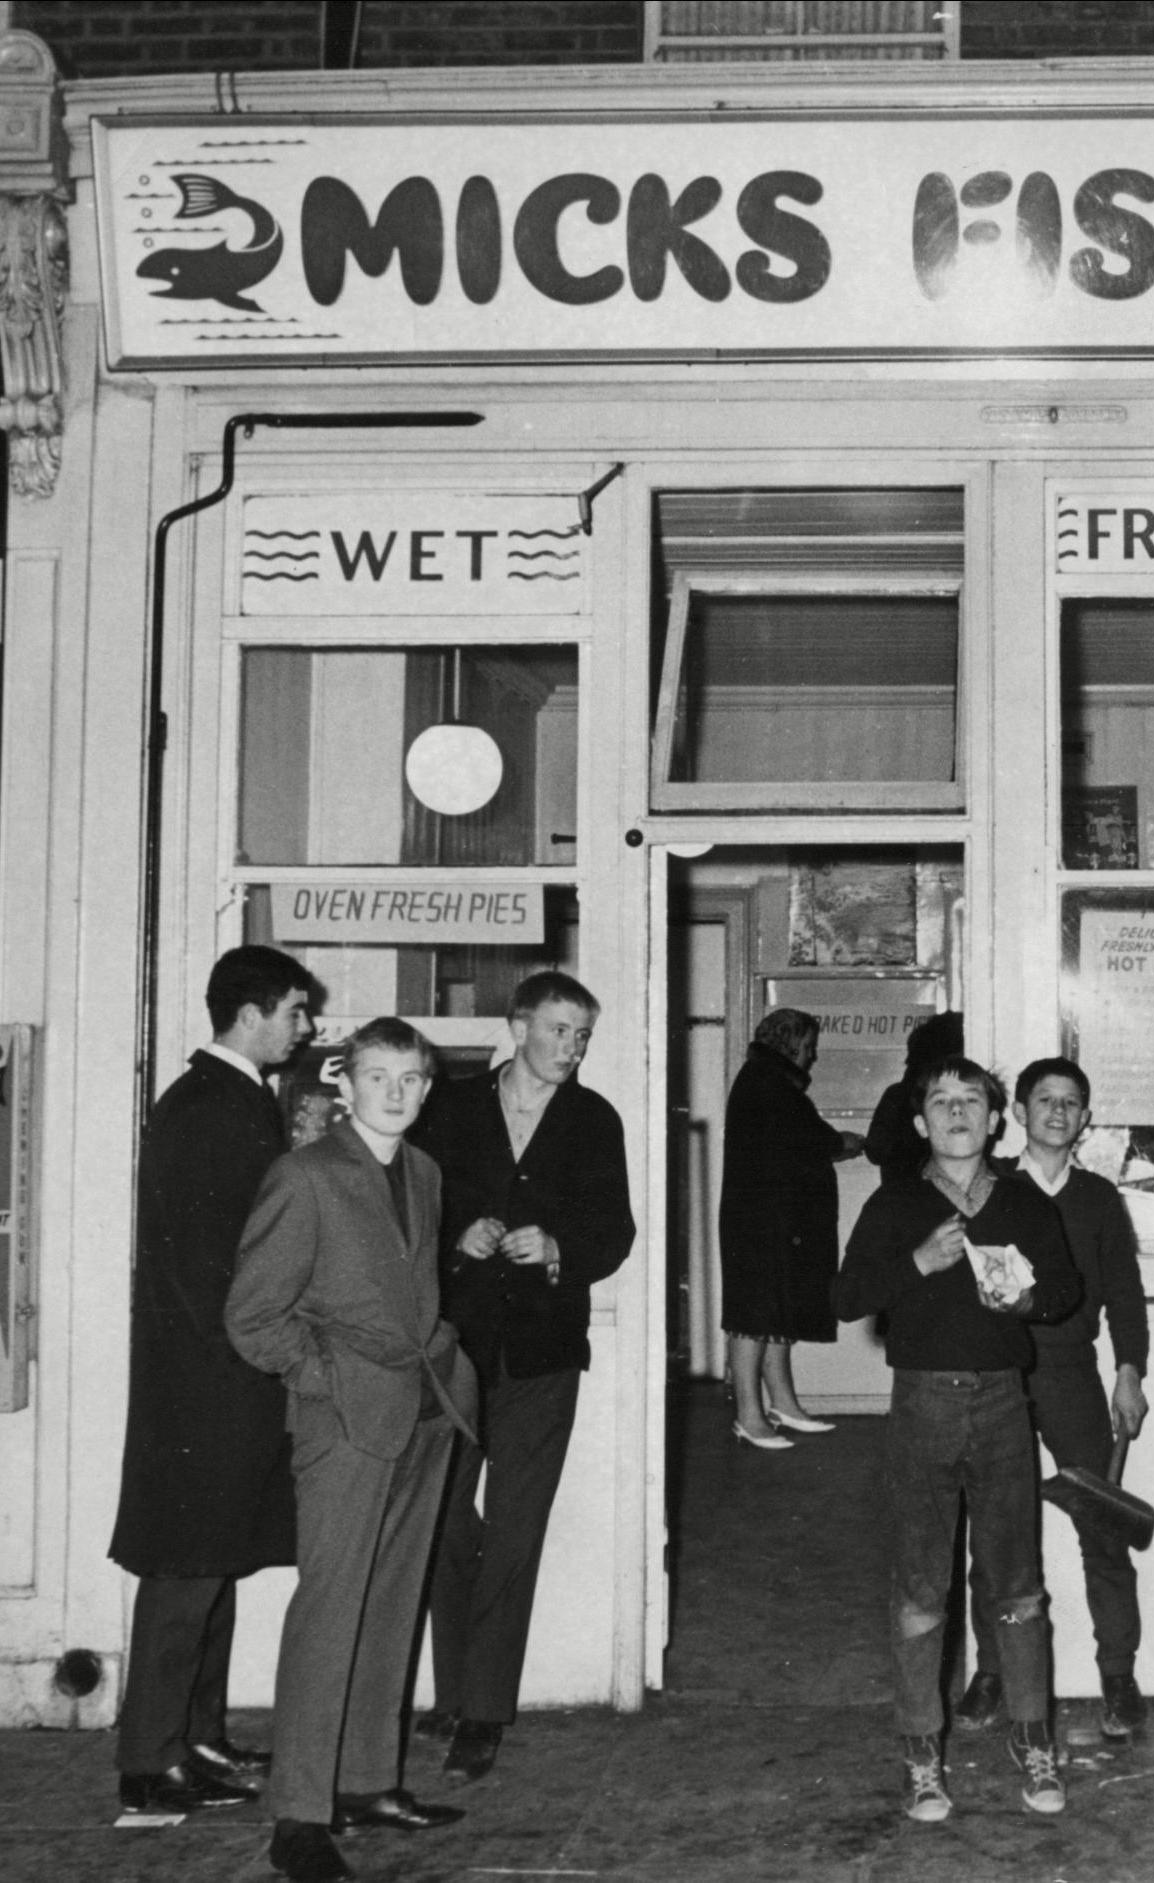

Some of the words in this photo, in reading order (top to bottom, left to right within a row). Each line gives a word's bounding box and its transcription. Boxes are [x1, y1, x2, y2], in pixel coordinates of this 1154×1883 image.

[300, 170, 832, 305] MICKS
[330, 530, 498, 581] WET
[293, 889, 365, 921] OVEN
[370, 890, 462, 923] FRESH
[468, 892, 528, 924] PIES
[1107, 956, 1147, 972] HOT
[867, 1015, 897, 1034] HOT
